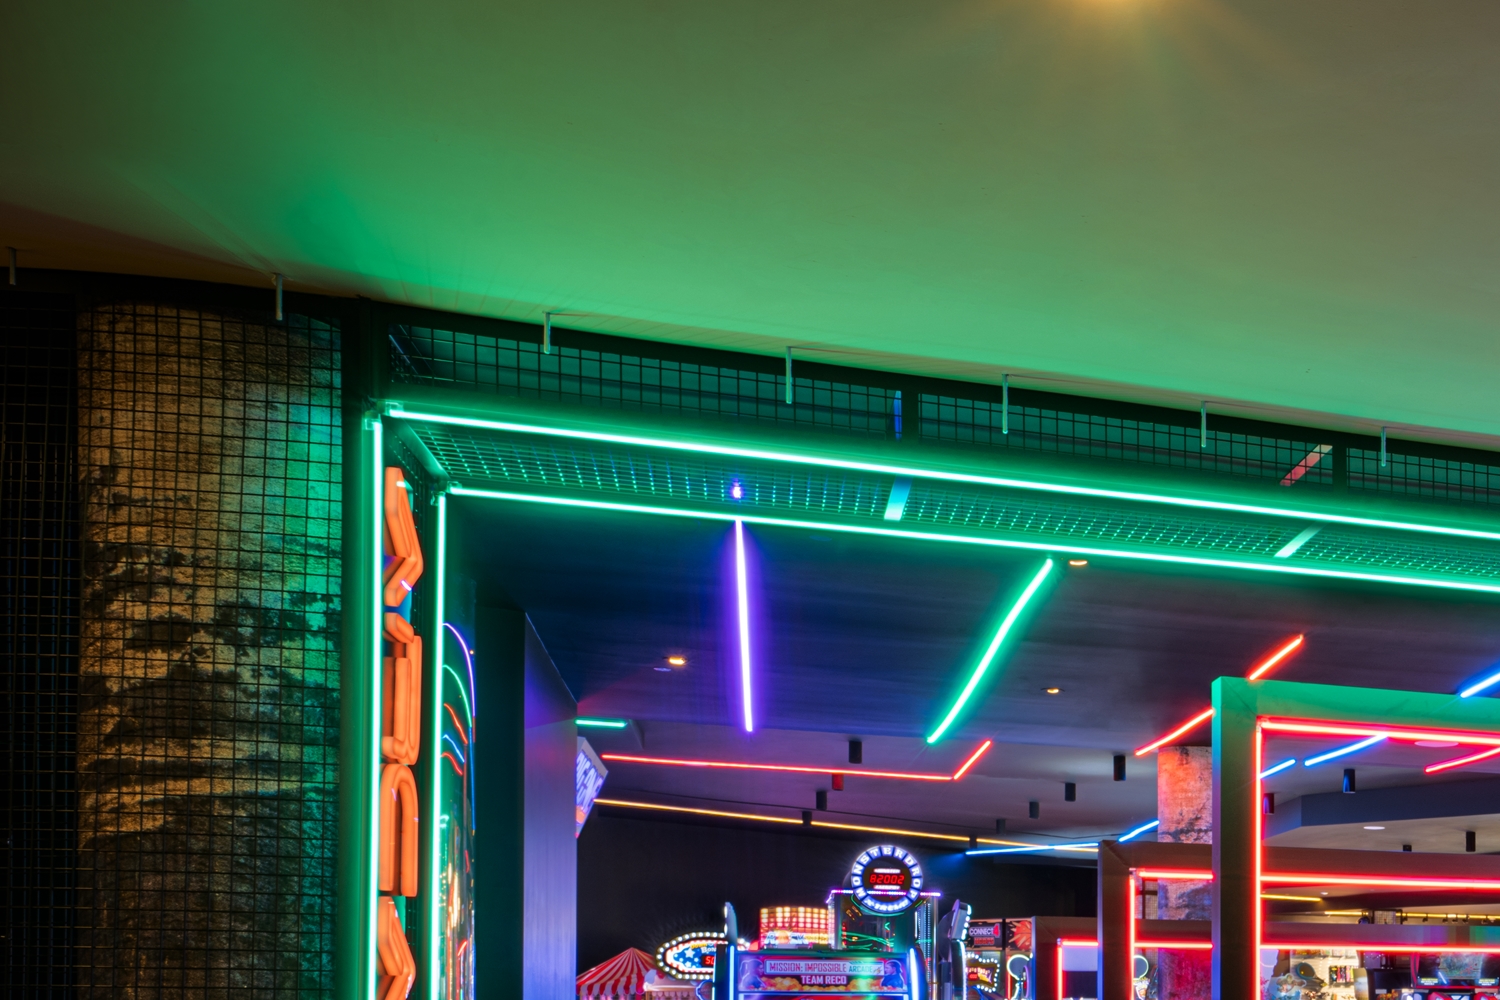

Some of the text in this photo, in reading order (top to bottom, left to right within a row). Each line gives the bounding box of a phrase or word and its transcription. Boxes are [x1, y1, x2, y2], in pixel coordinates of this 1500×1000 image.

[769, 962, 804, 972] MISSION:
[804, 962, 847, 972] IMPOSSIBLE
[801, 975, 847, 985] TEAM RECO
